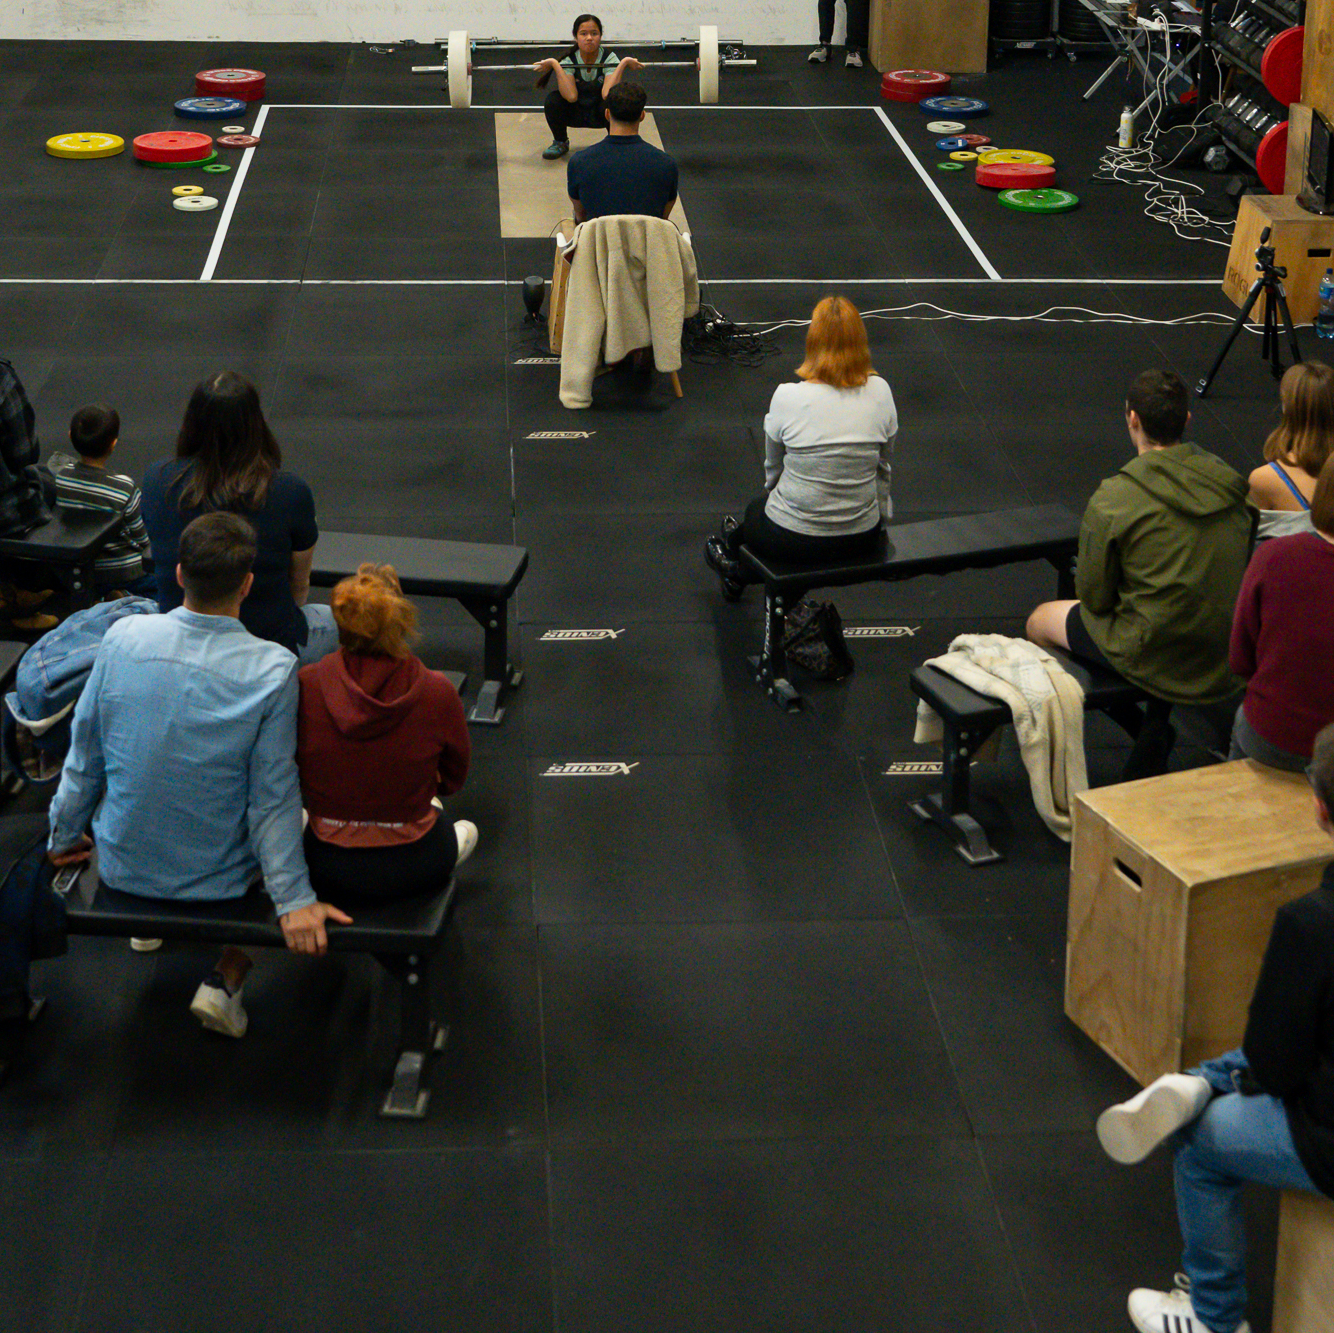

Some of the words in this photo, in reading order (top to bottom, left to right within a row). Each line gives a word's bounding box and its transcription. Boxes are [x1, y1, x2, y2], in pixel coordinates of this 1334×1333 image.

[1228, 266, 1250, 298] ROG
[535, 628, 626, 641] XENIOS
[540, 762, 640, 776] XENIOS
